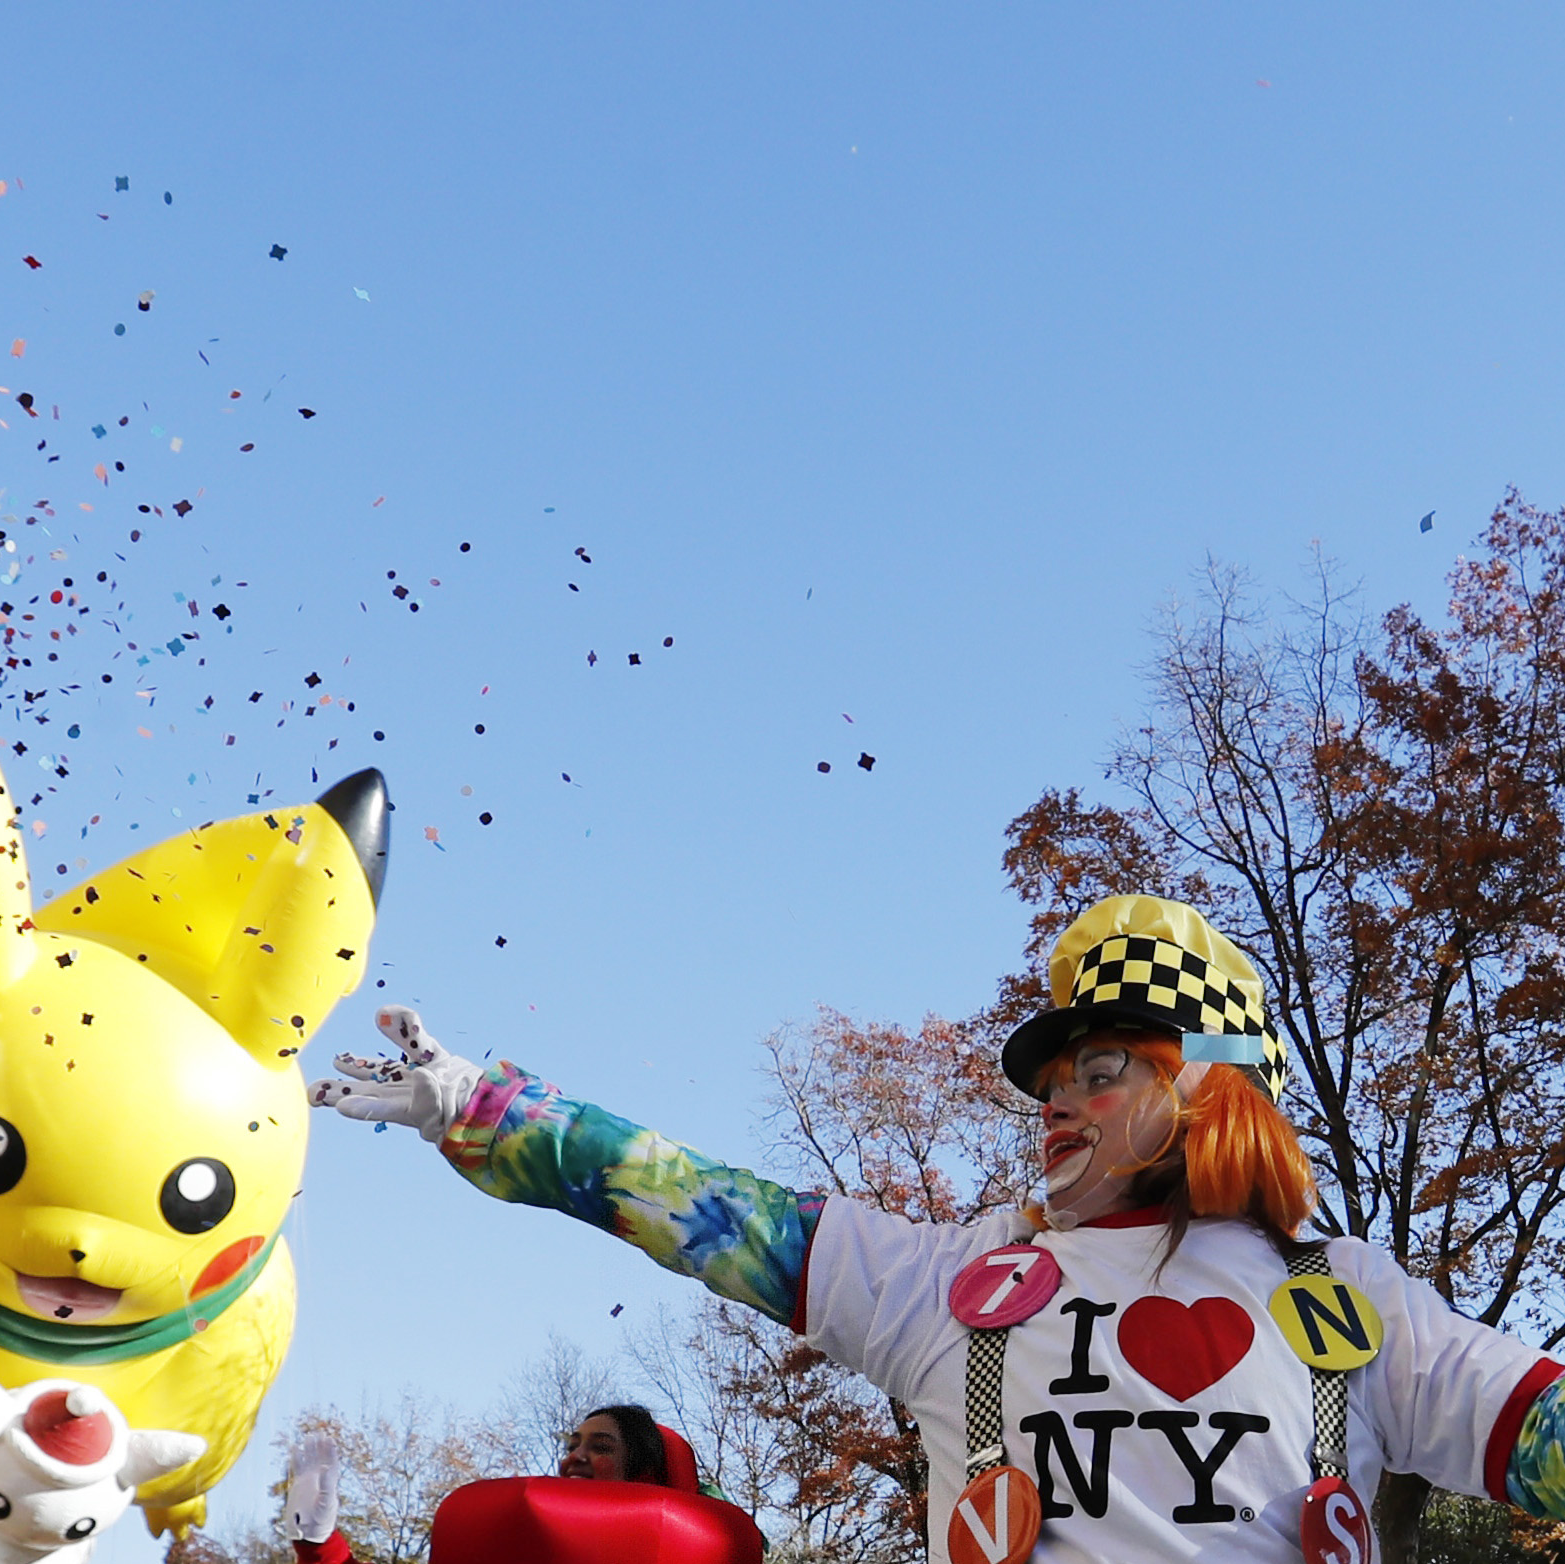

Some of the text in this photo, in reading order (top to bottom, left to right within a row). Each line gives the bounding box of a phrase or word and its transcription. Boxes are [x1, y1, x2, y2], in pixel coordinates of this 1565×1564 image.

[978, 1252, 1040, 1315] 7
[1048, 1297, 1117, 1396] I
[1290, 1284, 1371, 1356] N
